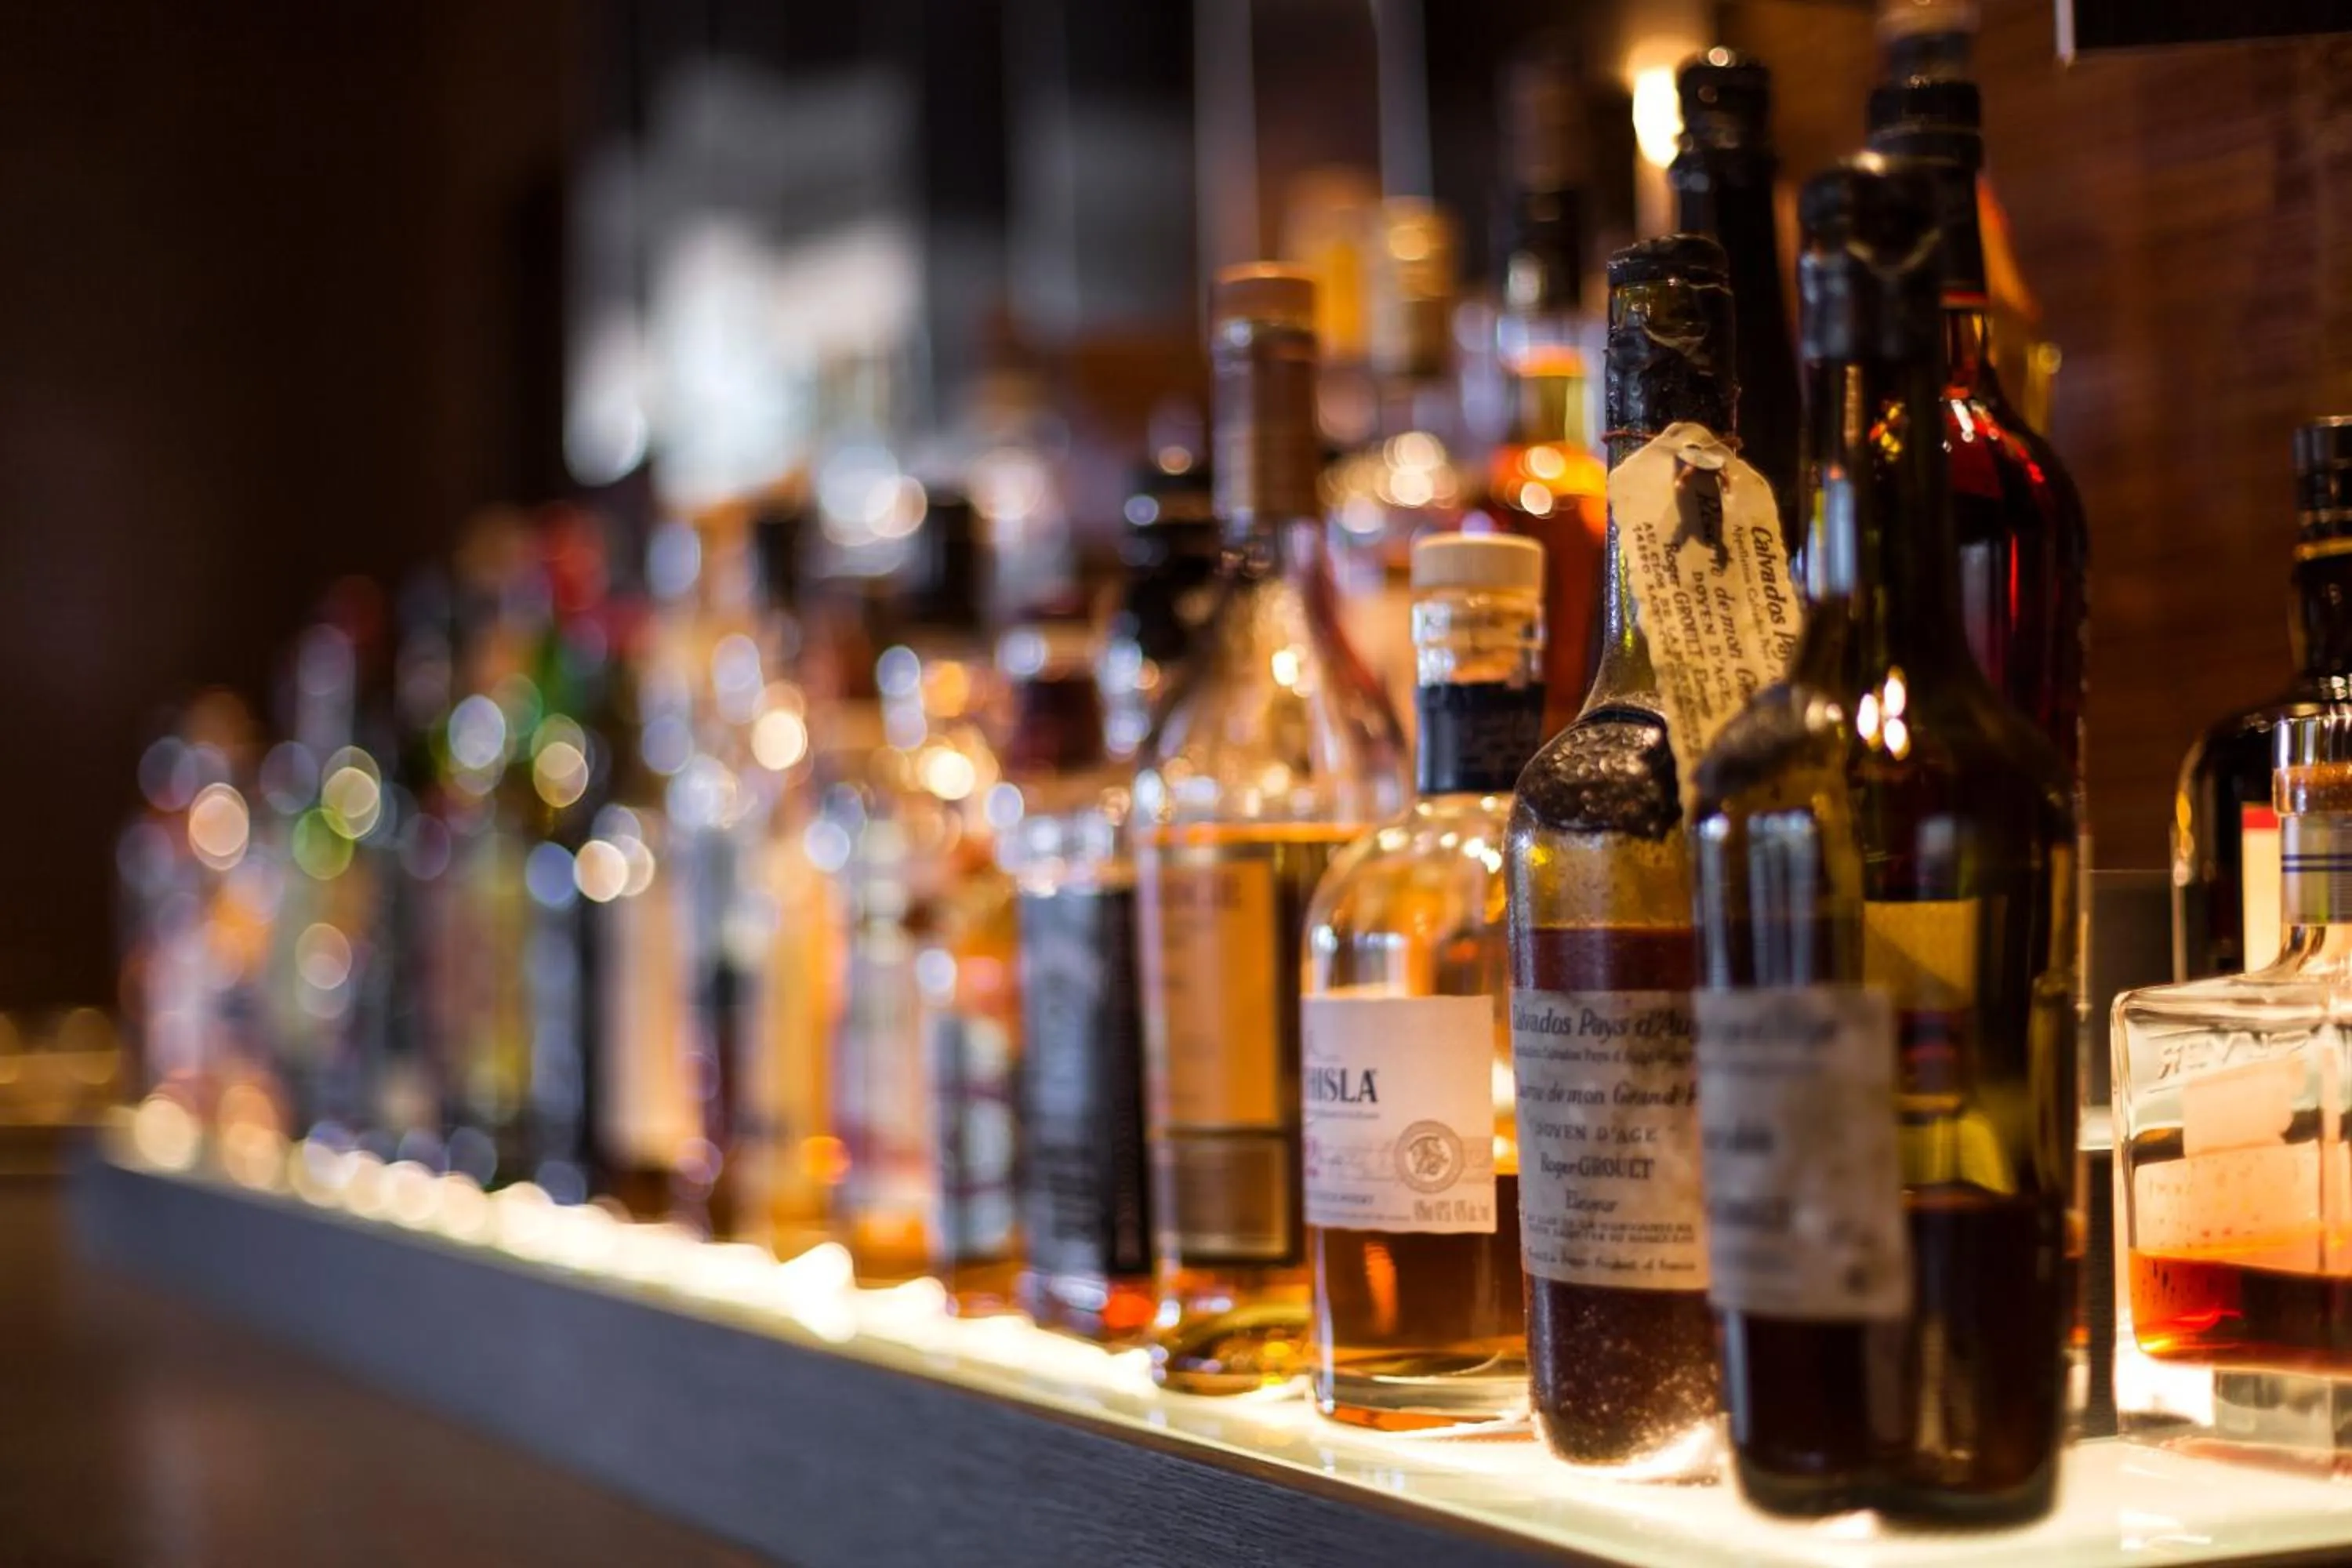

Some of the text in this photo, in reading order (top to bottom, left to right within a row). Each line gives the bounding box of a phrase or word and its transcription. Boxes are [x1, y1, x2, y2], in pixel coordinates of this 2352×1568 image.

[1662, 542, 1682, 588] Roger
[1673, 590, 1705, 660] GROULT
[1692, 570, 1717, 636] DOYEN
[1715, 586, 1736, 611] de
[1751, 526, 1788, 625] Calvados
[1771, 630, 1797, 661] Pay
[1720, 615, 1744, 659] mon
[1578, 1007, 1629, 1045] Pays
[1566, 1089, 1606, 1105] mon
